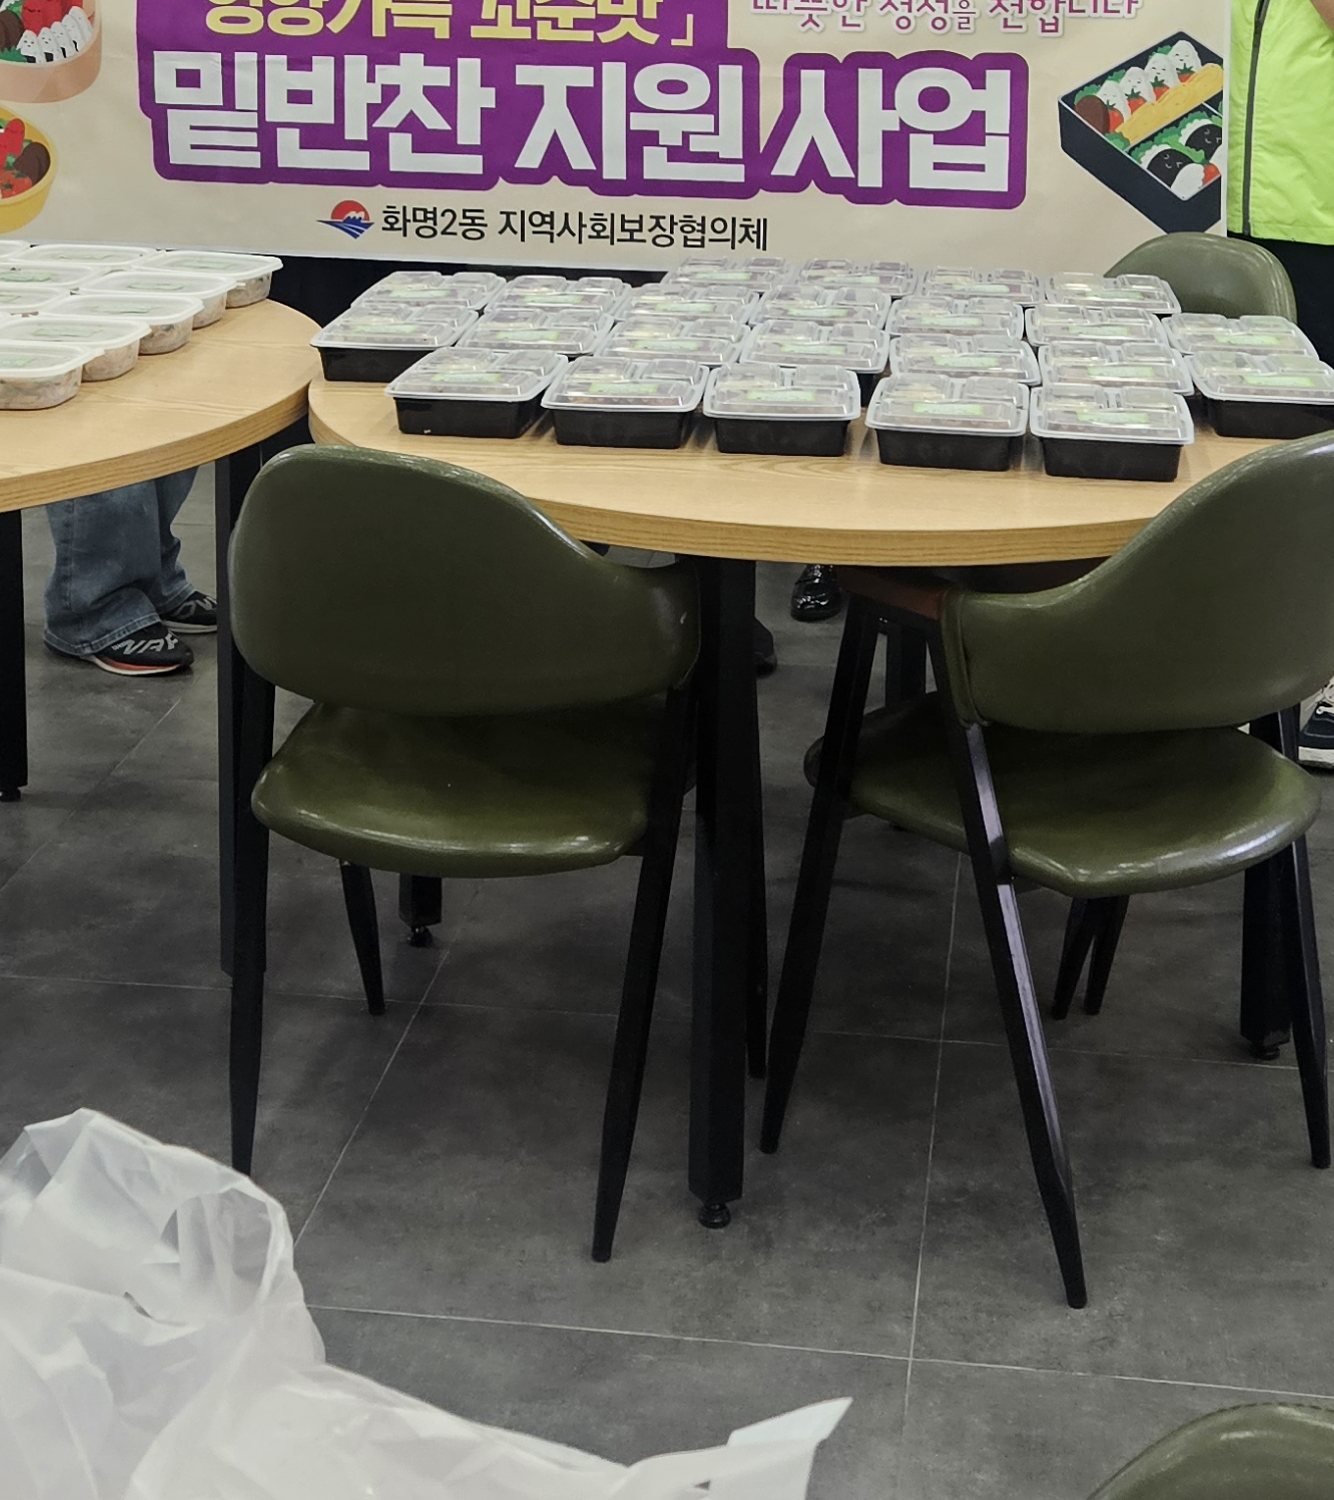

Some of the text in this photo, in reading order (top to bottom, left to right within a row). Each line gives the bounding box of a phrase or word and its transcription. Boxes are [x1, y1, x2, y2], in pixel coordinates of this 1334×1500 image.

[153, 50, 497, 175] 밑반찬
[381, 204, 769, 252] 화명2동 지역사회보장협의체
